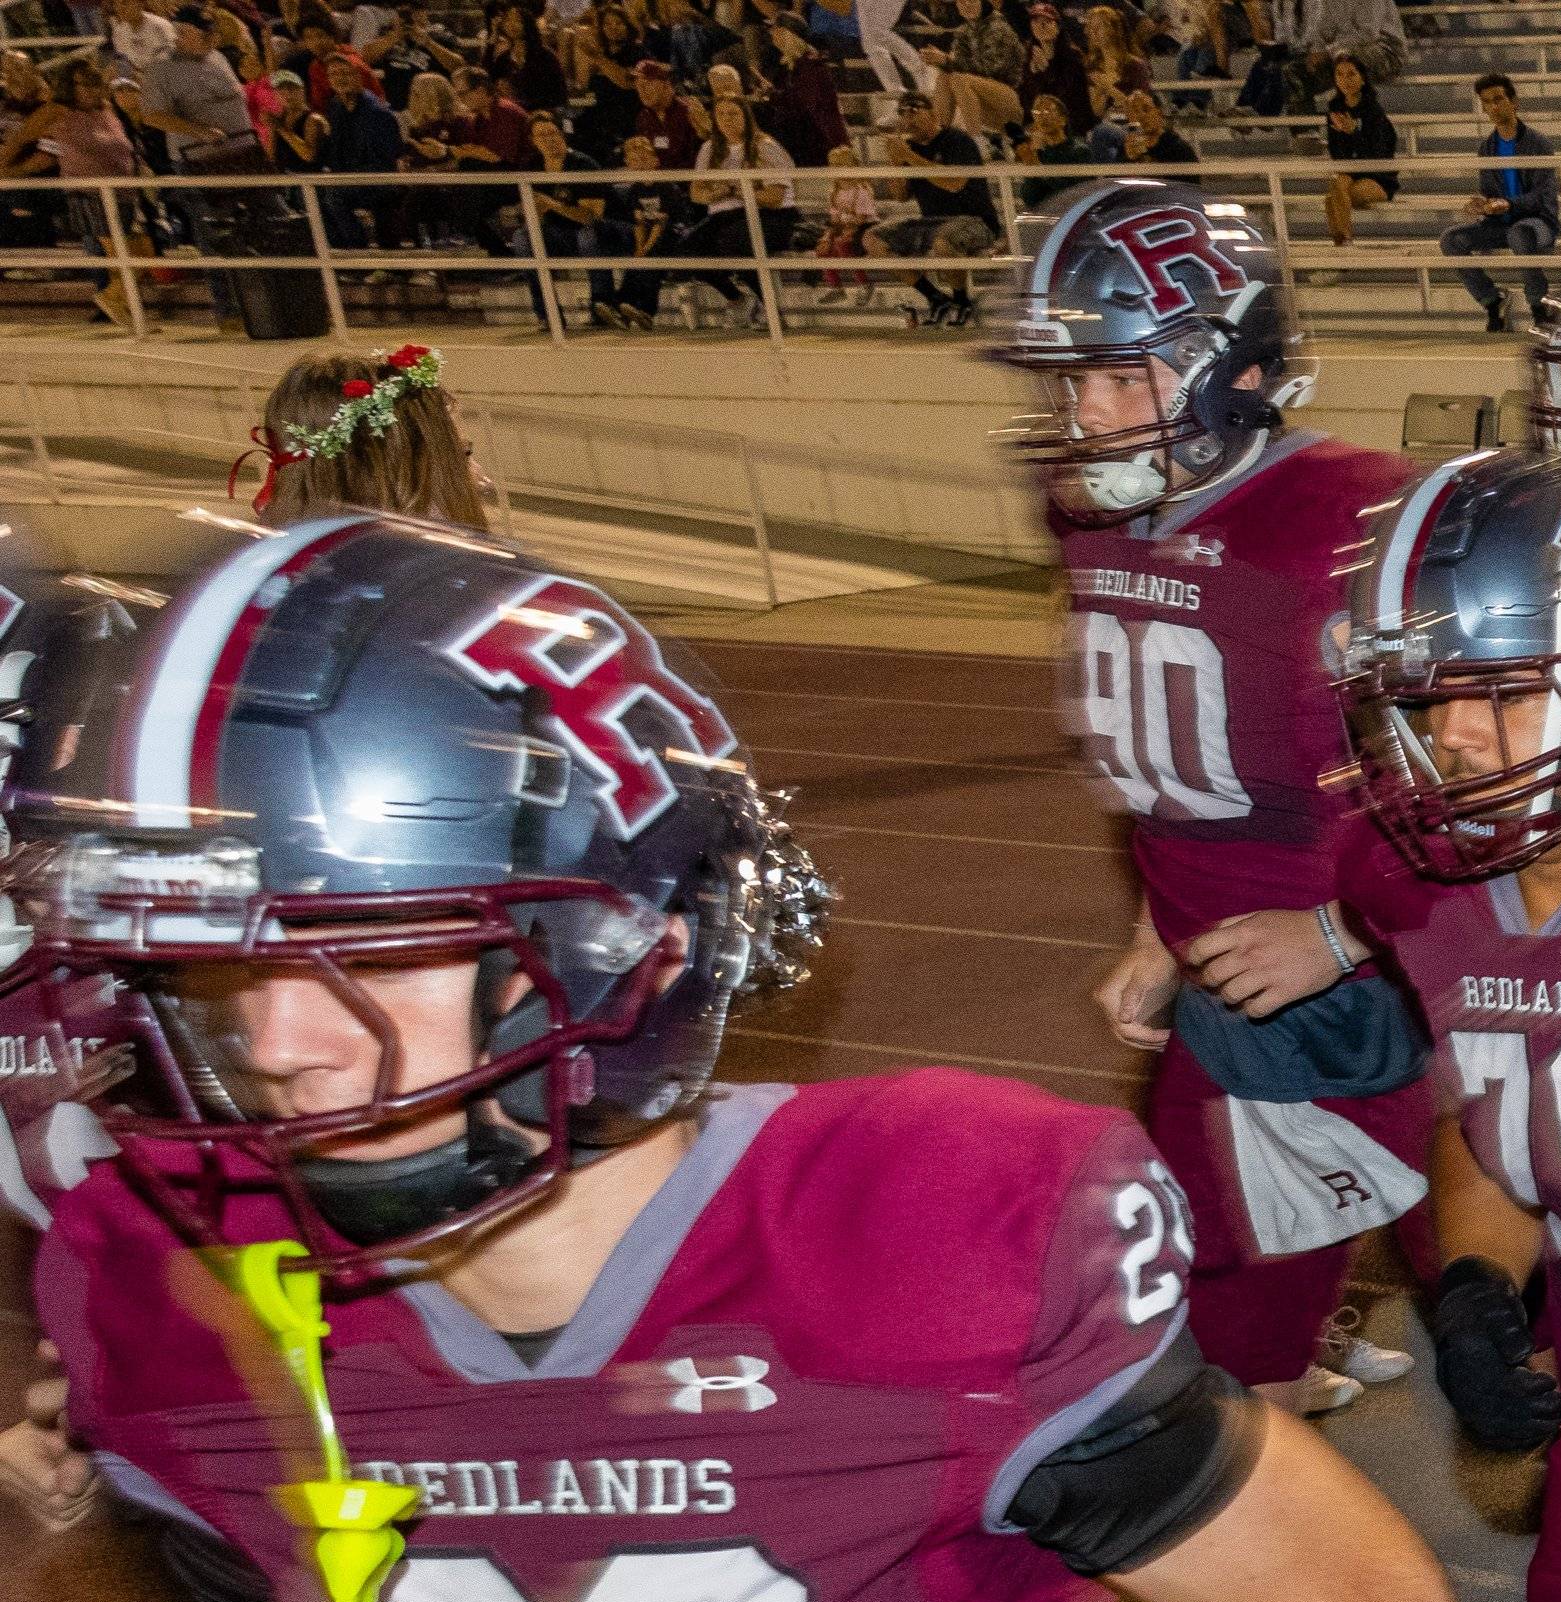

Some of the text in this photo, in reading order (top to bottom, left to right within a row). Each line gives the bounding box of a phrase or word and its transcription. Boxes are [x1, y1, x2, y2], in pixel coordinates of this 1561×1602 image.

[1100, 203, 1249, 322] R
[1092, 567, 1201, 611] REDLANDS
[447, 573, 740, 843] R
[1084, 610, 1255, 820] 90
[1319, 1169, 1374, 1211] R
